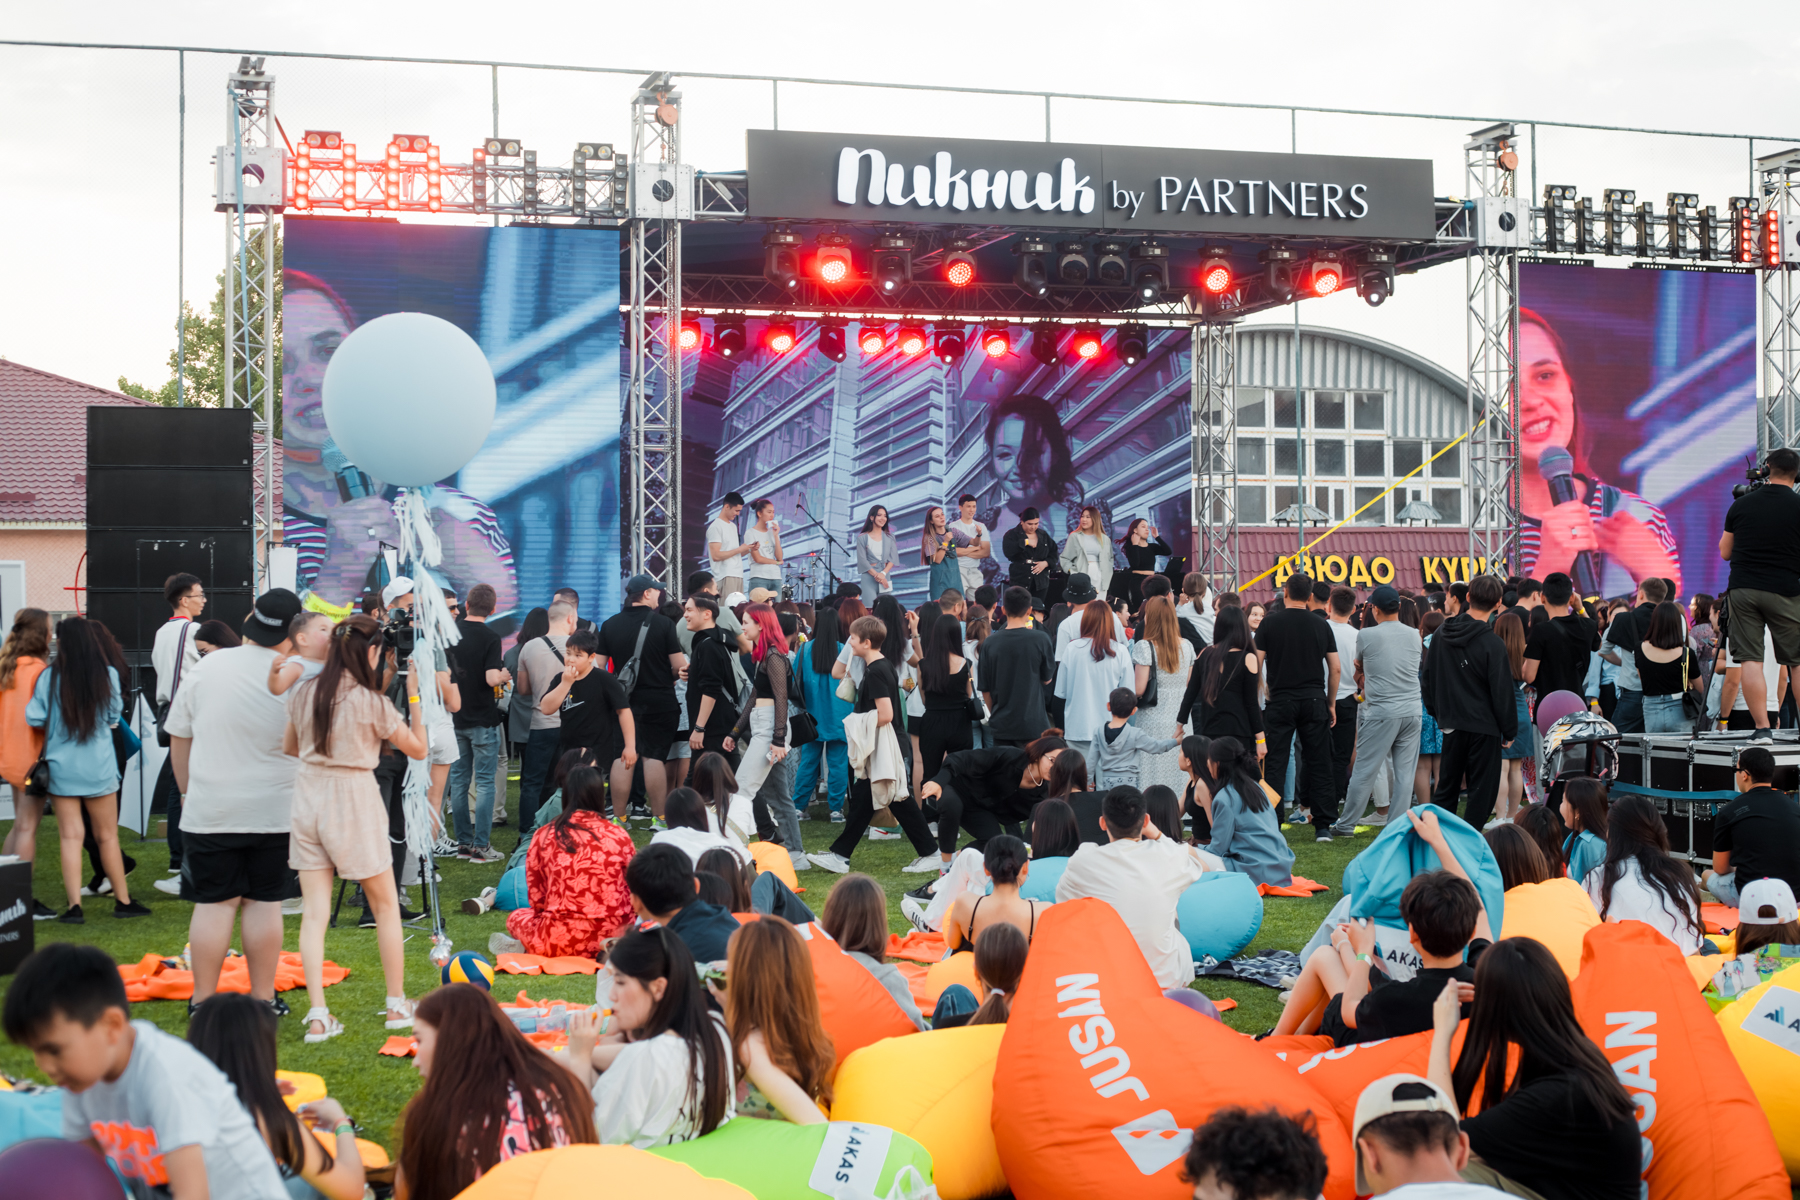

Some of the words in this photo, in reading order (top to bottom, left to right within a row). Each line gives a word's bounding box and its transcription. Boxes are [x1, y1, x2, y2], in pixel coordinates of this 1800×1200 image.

[1112, 179, 1145, 219] by
[1160, 176, 1370, 219] PARTNERS
[835, 1135, 862, 1184] AKAS
